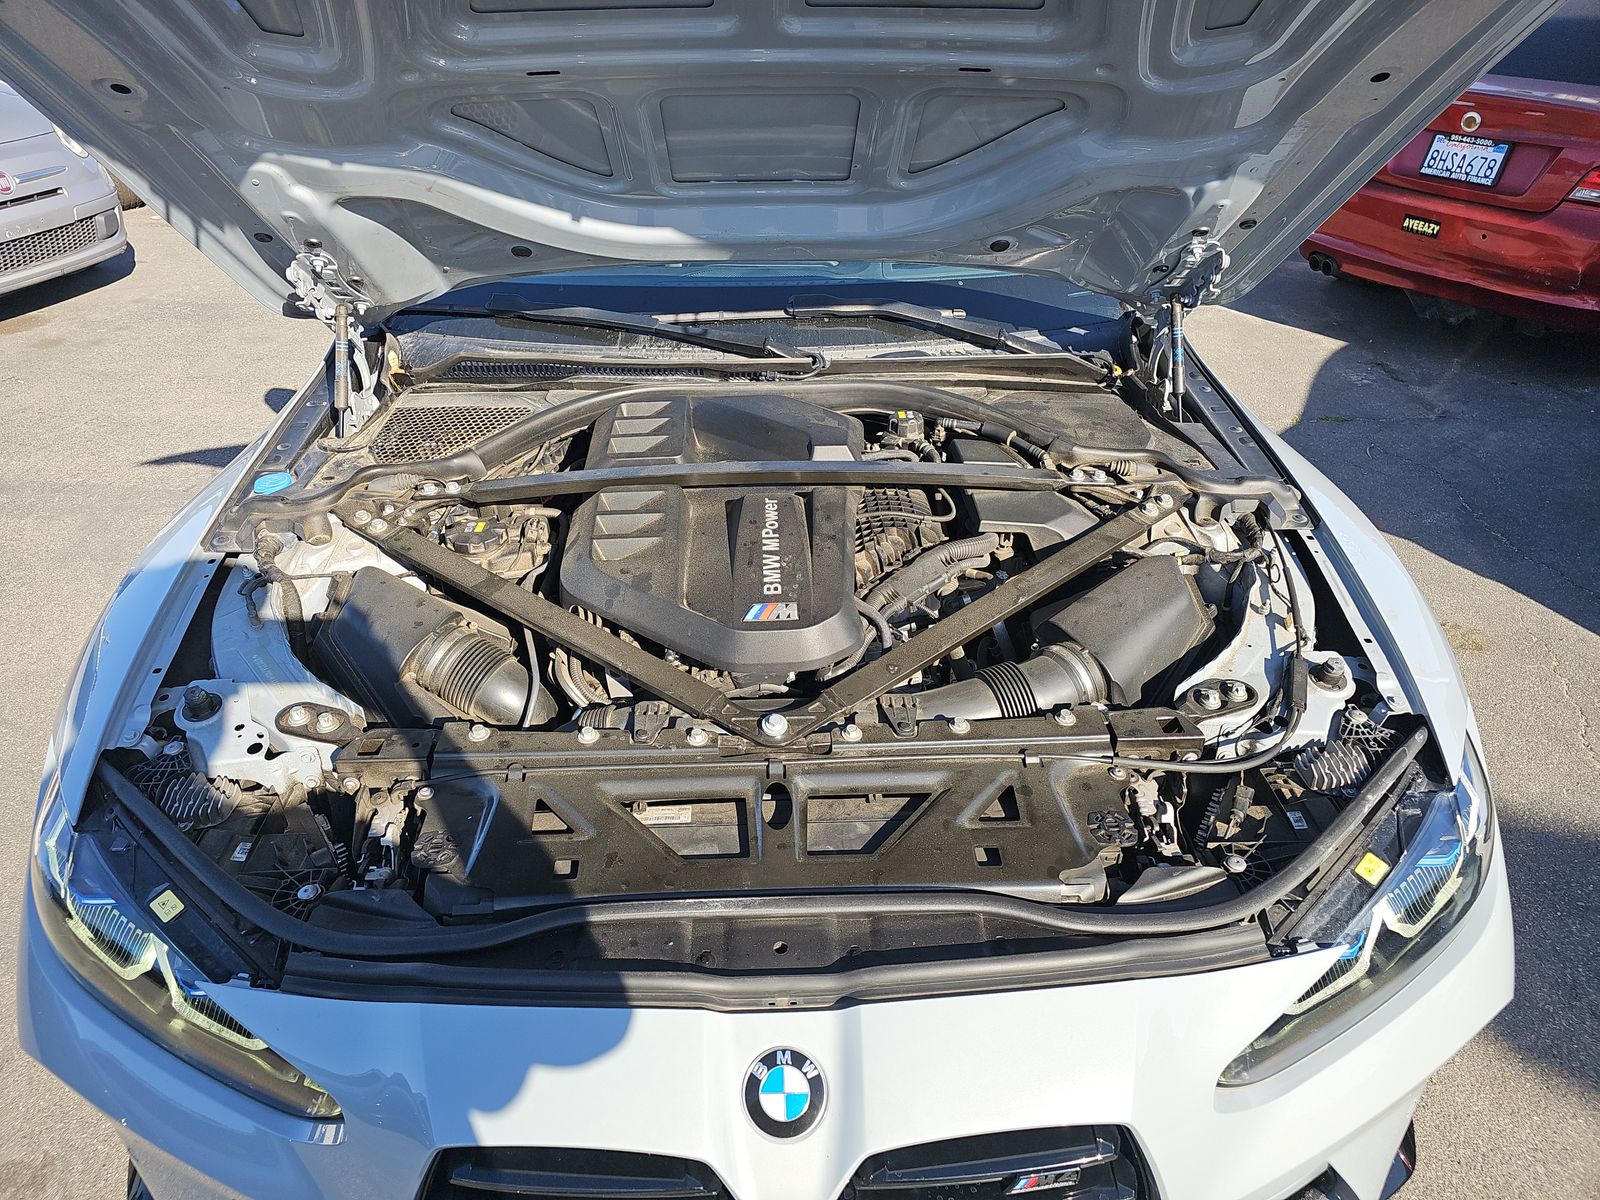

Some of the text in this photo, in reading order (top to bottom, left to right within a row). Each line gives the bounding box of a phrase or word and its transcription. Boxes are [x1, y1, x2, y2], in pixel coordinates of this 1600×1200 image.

[1427, 149, 1497, 178] 8HSA678
[1450, 172, 1467, 181] AUTO
[1466, 175, 1494, 186] FINANCE
[1403, 218, 1440, 235] AYEEAZY
[762, 498, 782, 595] BMW MPower
[752, 1050, 819, 1080] BMW
